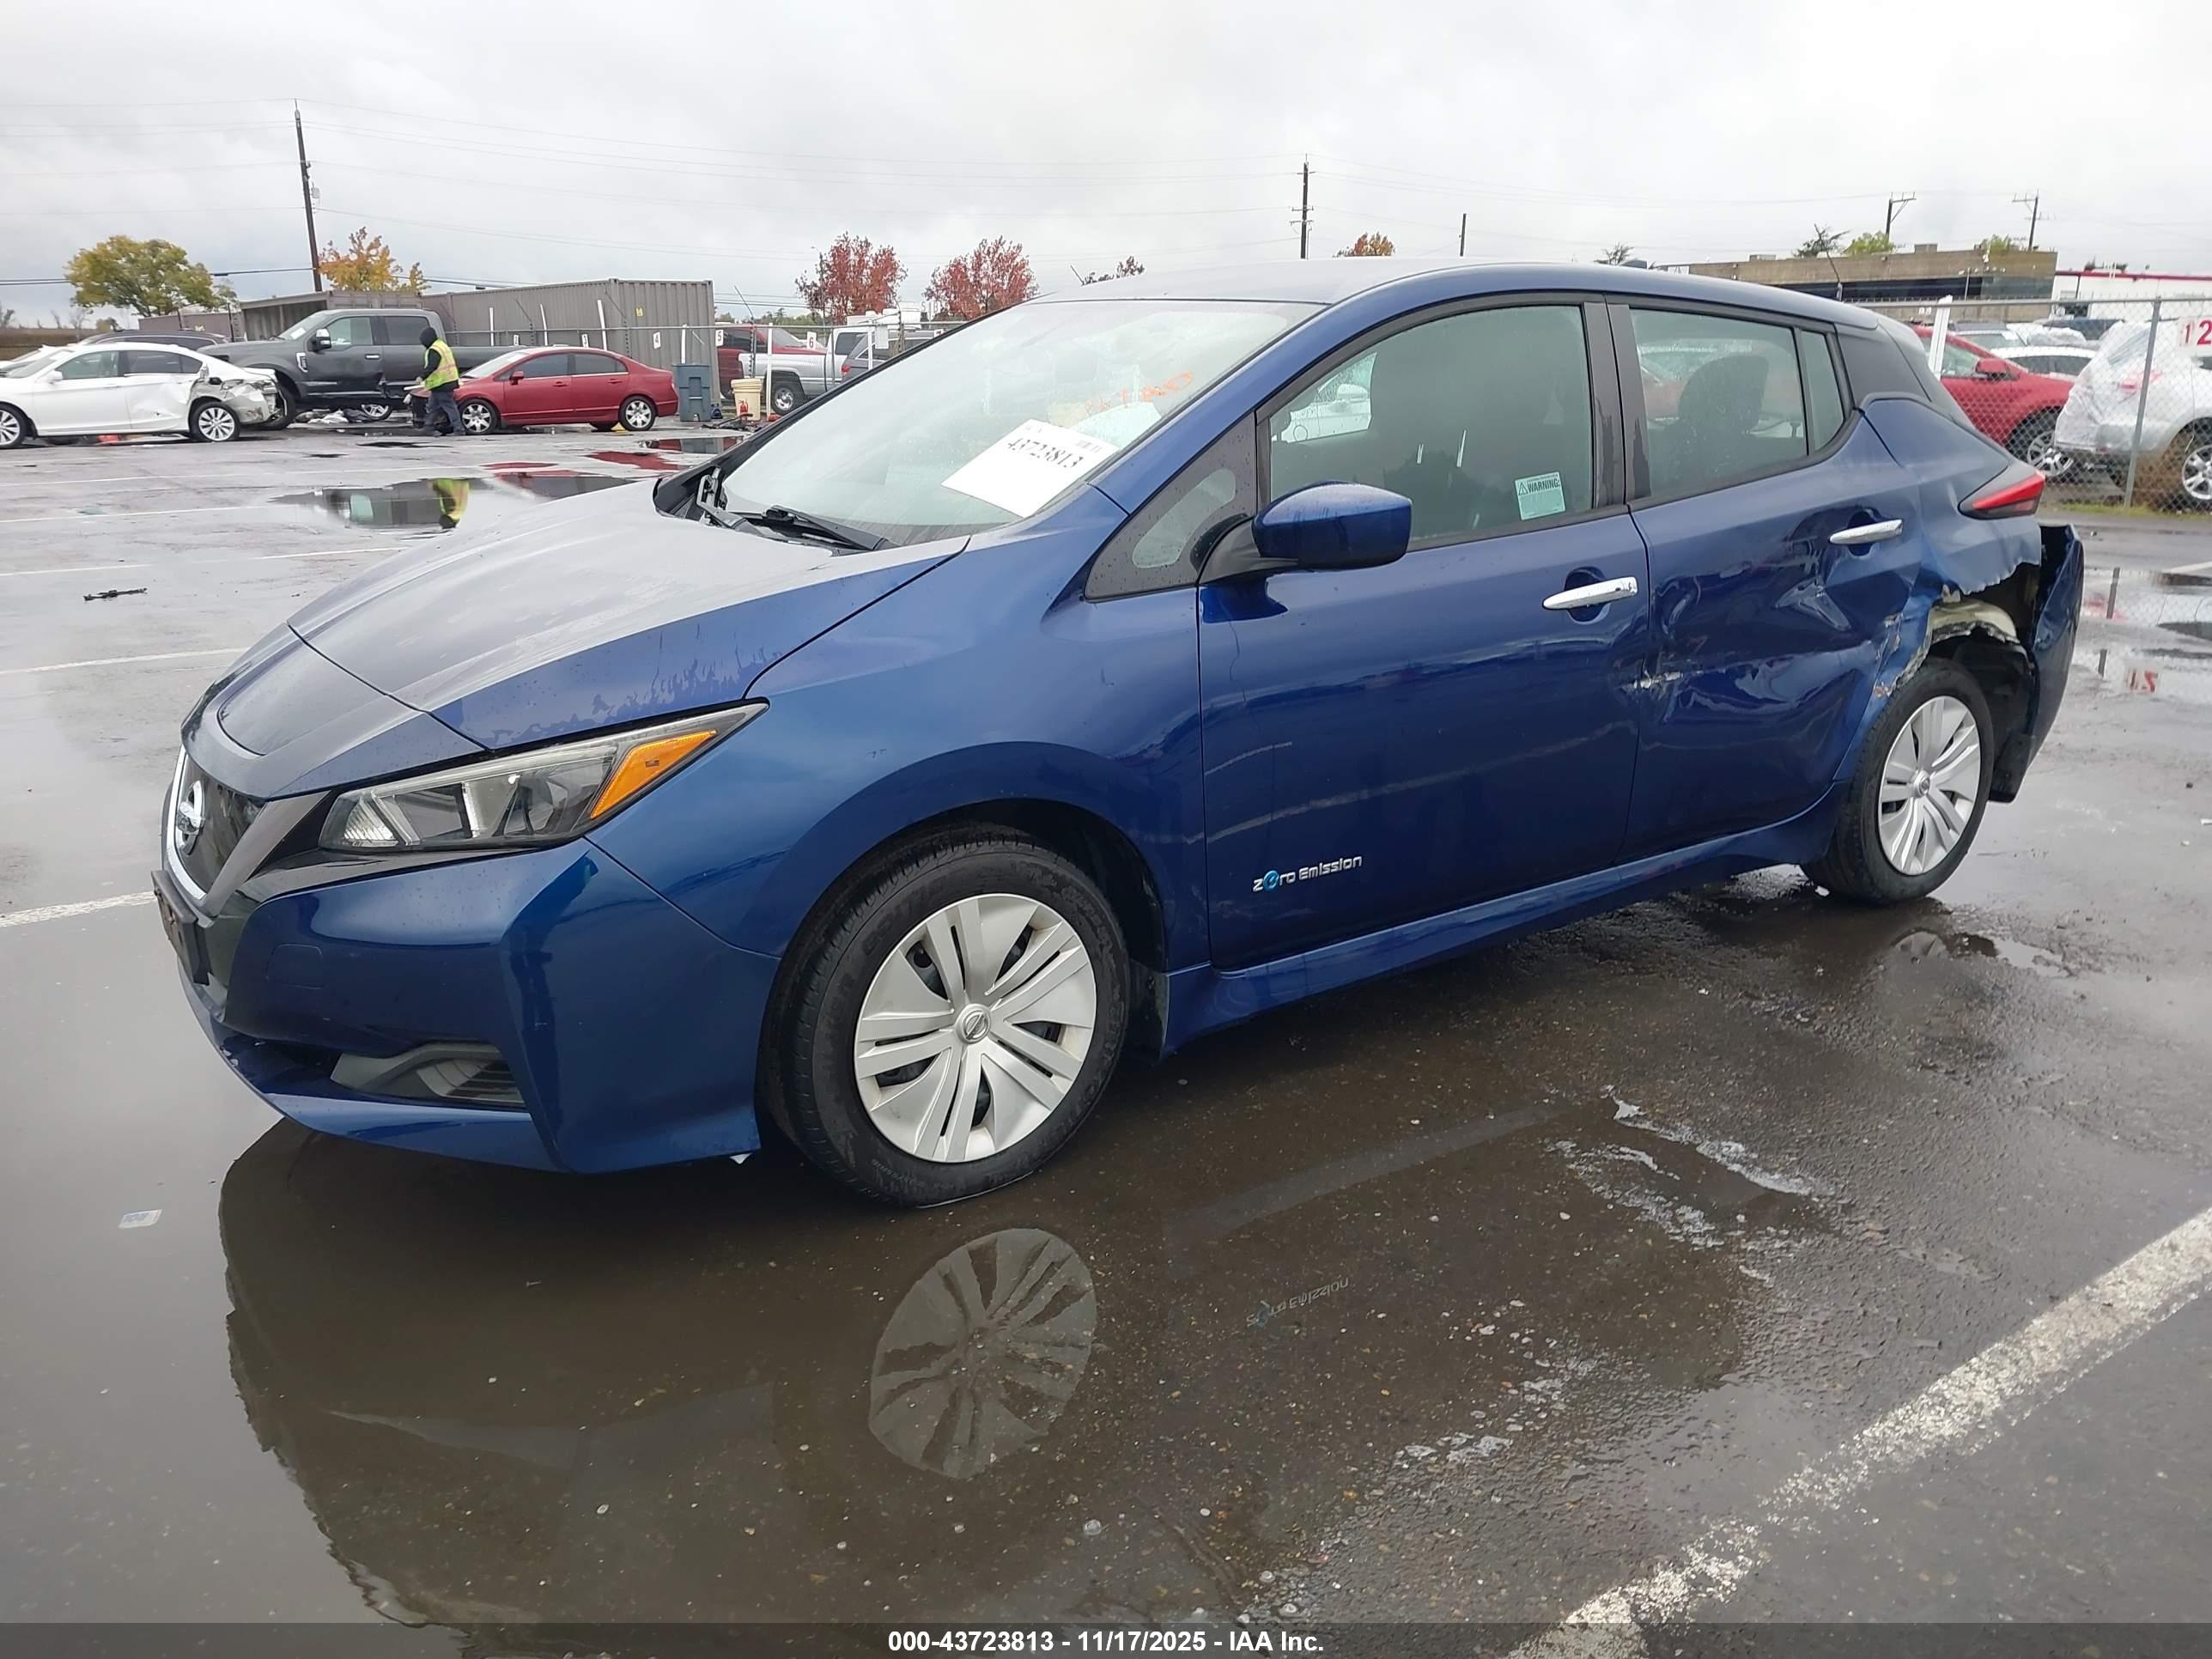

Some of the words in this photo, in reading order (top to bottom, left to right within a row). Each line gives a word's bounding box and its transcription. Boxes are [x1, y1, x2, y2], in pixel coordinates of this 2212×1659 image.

[717, 330, 722, 342] 5
[808, 337, 814, 349] 6
[1006, 436, 1084, 469] 43723813
[1527, 477, 1561, 494] WARNING:
